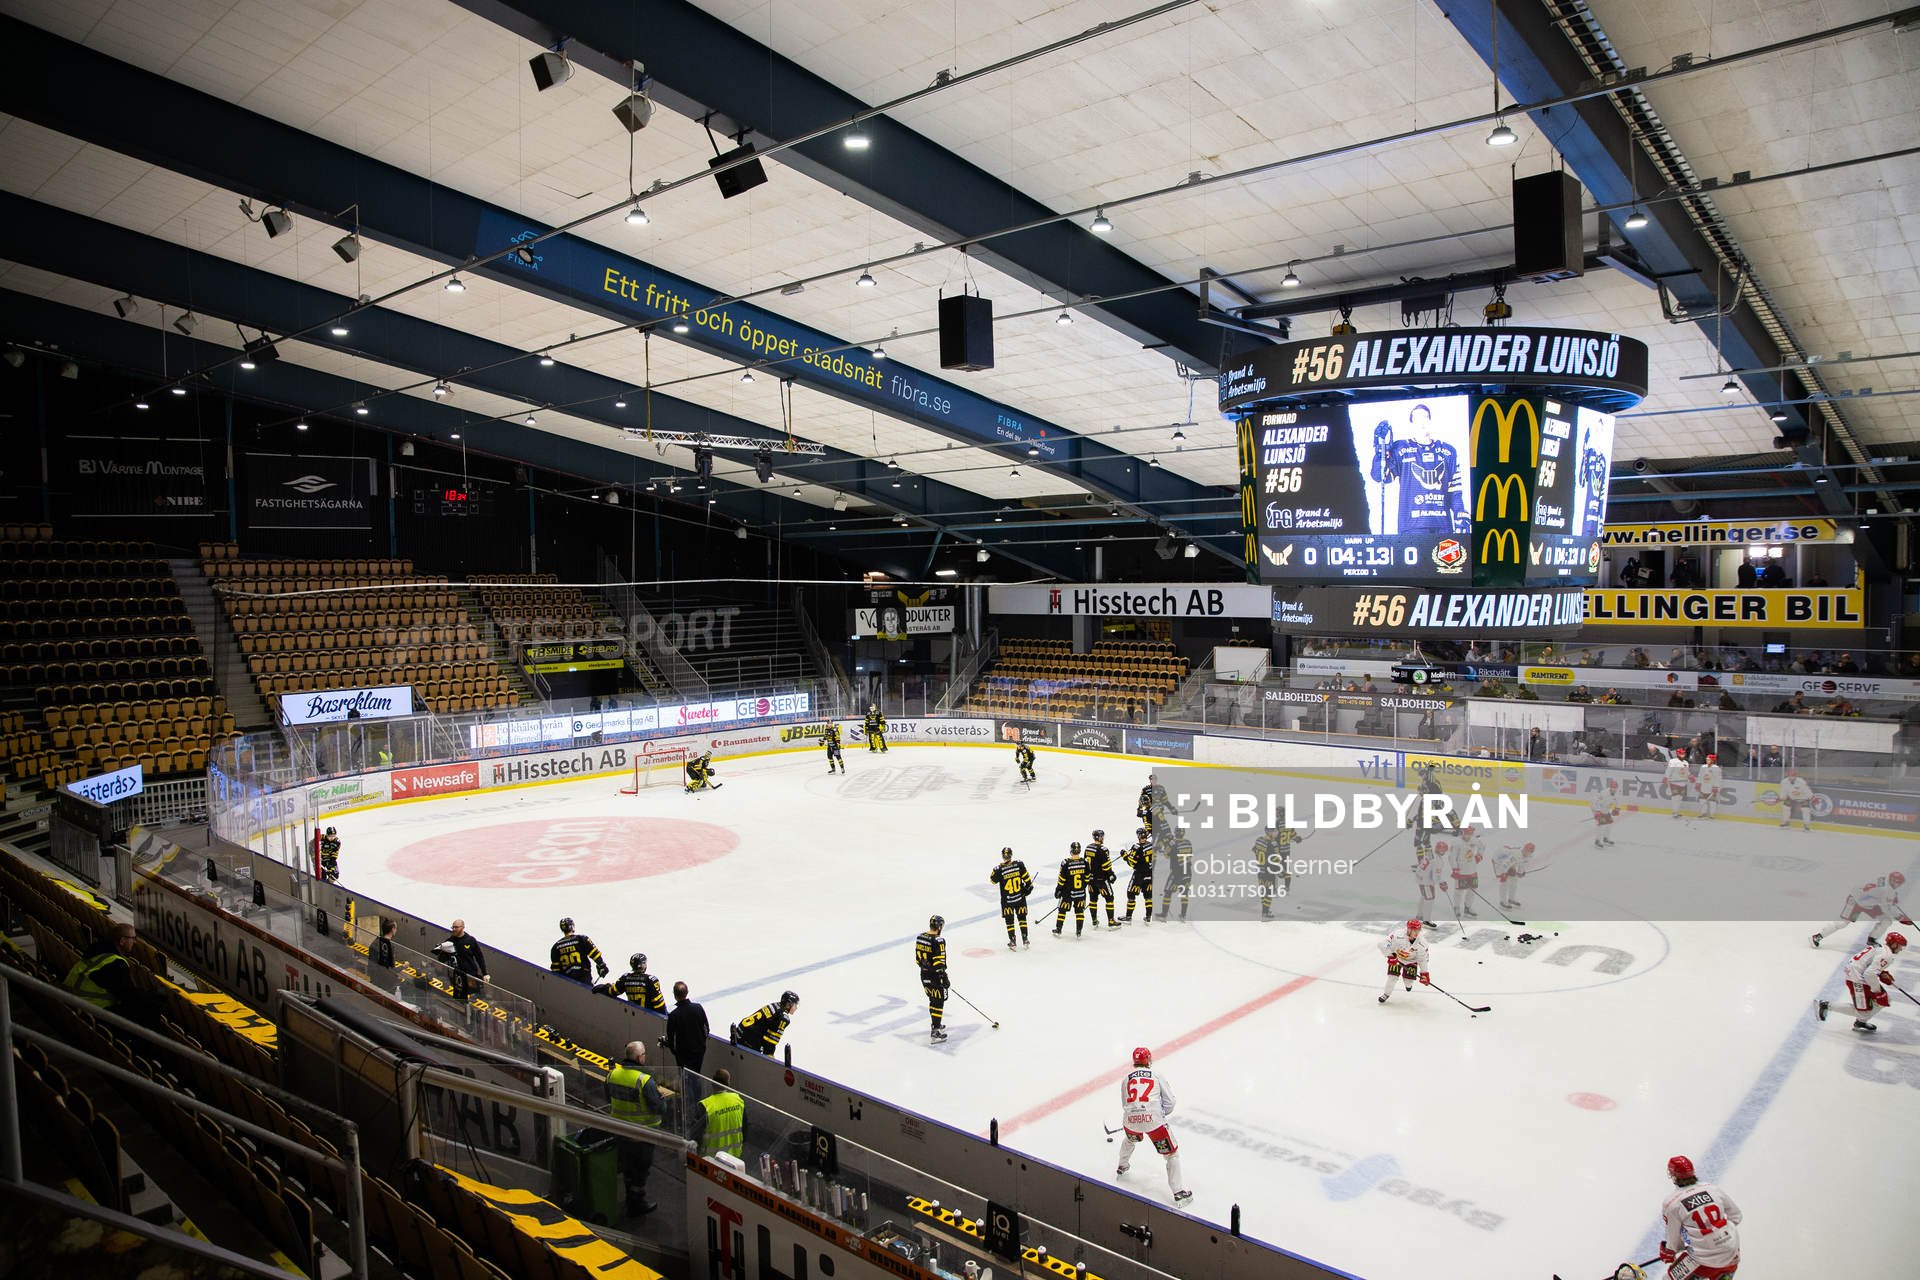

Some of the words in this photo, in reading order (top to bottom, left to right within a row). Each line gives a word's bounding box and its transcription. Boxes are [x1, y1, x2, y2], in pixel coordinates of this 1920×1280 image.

[603, 268, 639, 302] Ett
[646, 283, 690, 320] fritt
[695, 305, 734, 337] och
[739, 320, 799, 363] öppet
[802, 345, 884, 391] stadsnät
[890, 374, 952, 416] fibra.se
[1292, 343, 1345, 385] #56
[1346, 334, 1530, 378] ALEXANDER
[1533, 334, 1620, 378] LUNSJÖ
[1247, 363, 1254, 377] &
[1228, 378, 1267, 398] Arbetsmiljö
[998, 415, 1023, 432] FIBRA
[1262, 412, 1297, 426] FORWARD
[1263, 425, 1329, 446] ALEXANDER
[1264, 444, 1306, 465] LUNSJÖ
[1265, 467, 1303, 494] #56
[167, 497, 203, 506] NIBE
[255, 496, 363, 510] FASTIGHETSÄGARNA
[1323, 508, 1331, 517] &
[1295, 518, 1343, 530] Arbetsmiljö
[1345, 537, 1364, 545] WARM
[1366, 537, 1374, 545] UP
[1304, 547, 1317, 565] 0
[1404, 547, 1418, 565] 0
[1074, 588, 1178, 616] Hisstech
[1186, 589, 1224, 616] AB
[1353, 595, 1406, 626] #56
[1408, 592, 1552, 627] ALEXANDER
[1786, 594, 1860, 623] BIL
[305, 691, 392, 719] Basreklam
[1265, 691, 1323, 704] SALBOHEDS
[1380, 697, 1446, 711] SALBOHEDS
[678, 706, 719, 725] Swetex
[723, 735, 771, 747] Raumaster
[781, 725, 804, 743] JB
[1083, 736, 1100, 747] RÖR
[507, 750, 593, 784] Hisstech
[599, 748, 627, 770] AB
[1357, 754, 1392, 780] vlt
[412, 767, 474, 790] Newsafe
[1833, 806, 1909, 822] KYLINDUSTRI
[1839, 799, 1888, 811] FRANCKS
[1004, 877, 1021, 894] 40
[147, 887, 229, 980] Hisstech
[236, 938, 269, 1003] AB
[1127, 1077, 1154, 1103] 67
